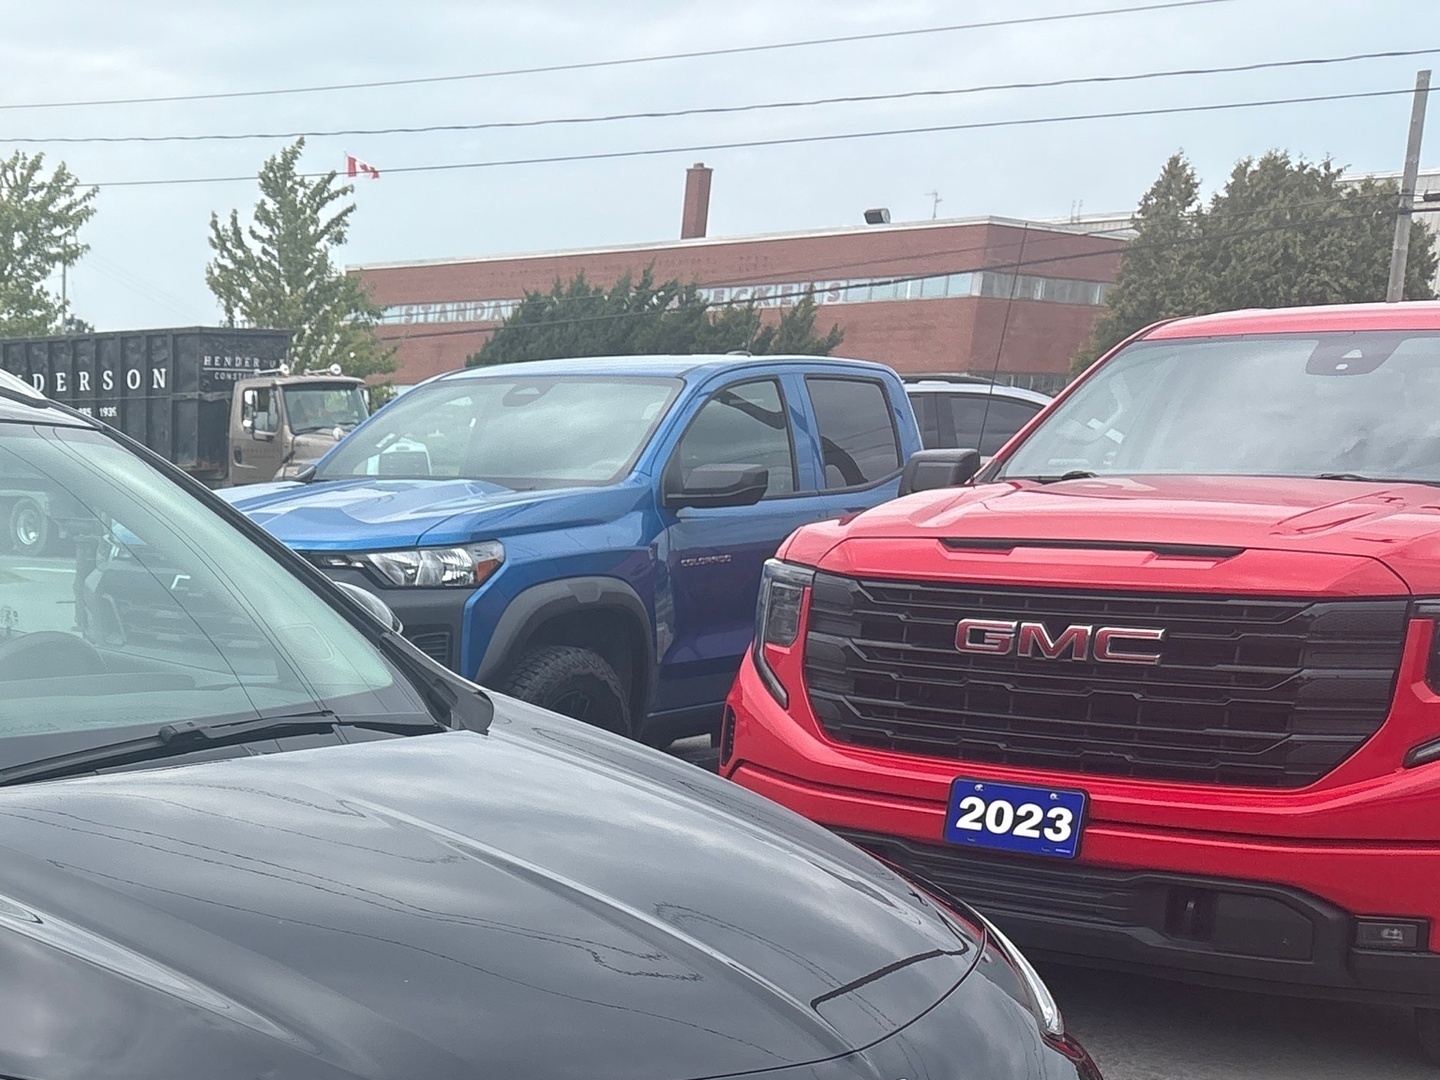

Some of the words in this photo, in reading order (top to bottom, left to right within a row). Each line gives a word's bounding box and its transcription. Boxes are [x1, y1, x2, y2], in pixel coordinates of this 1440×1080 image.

[17, 368, 168, 393] DERSON
[954, 618, 1165, 665] GMC
[956, 796, 1074, 842] 2023
